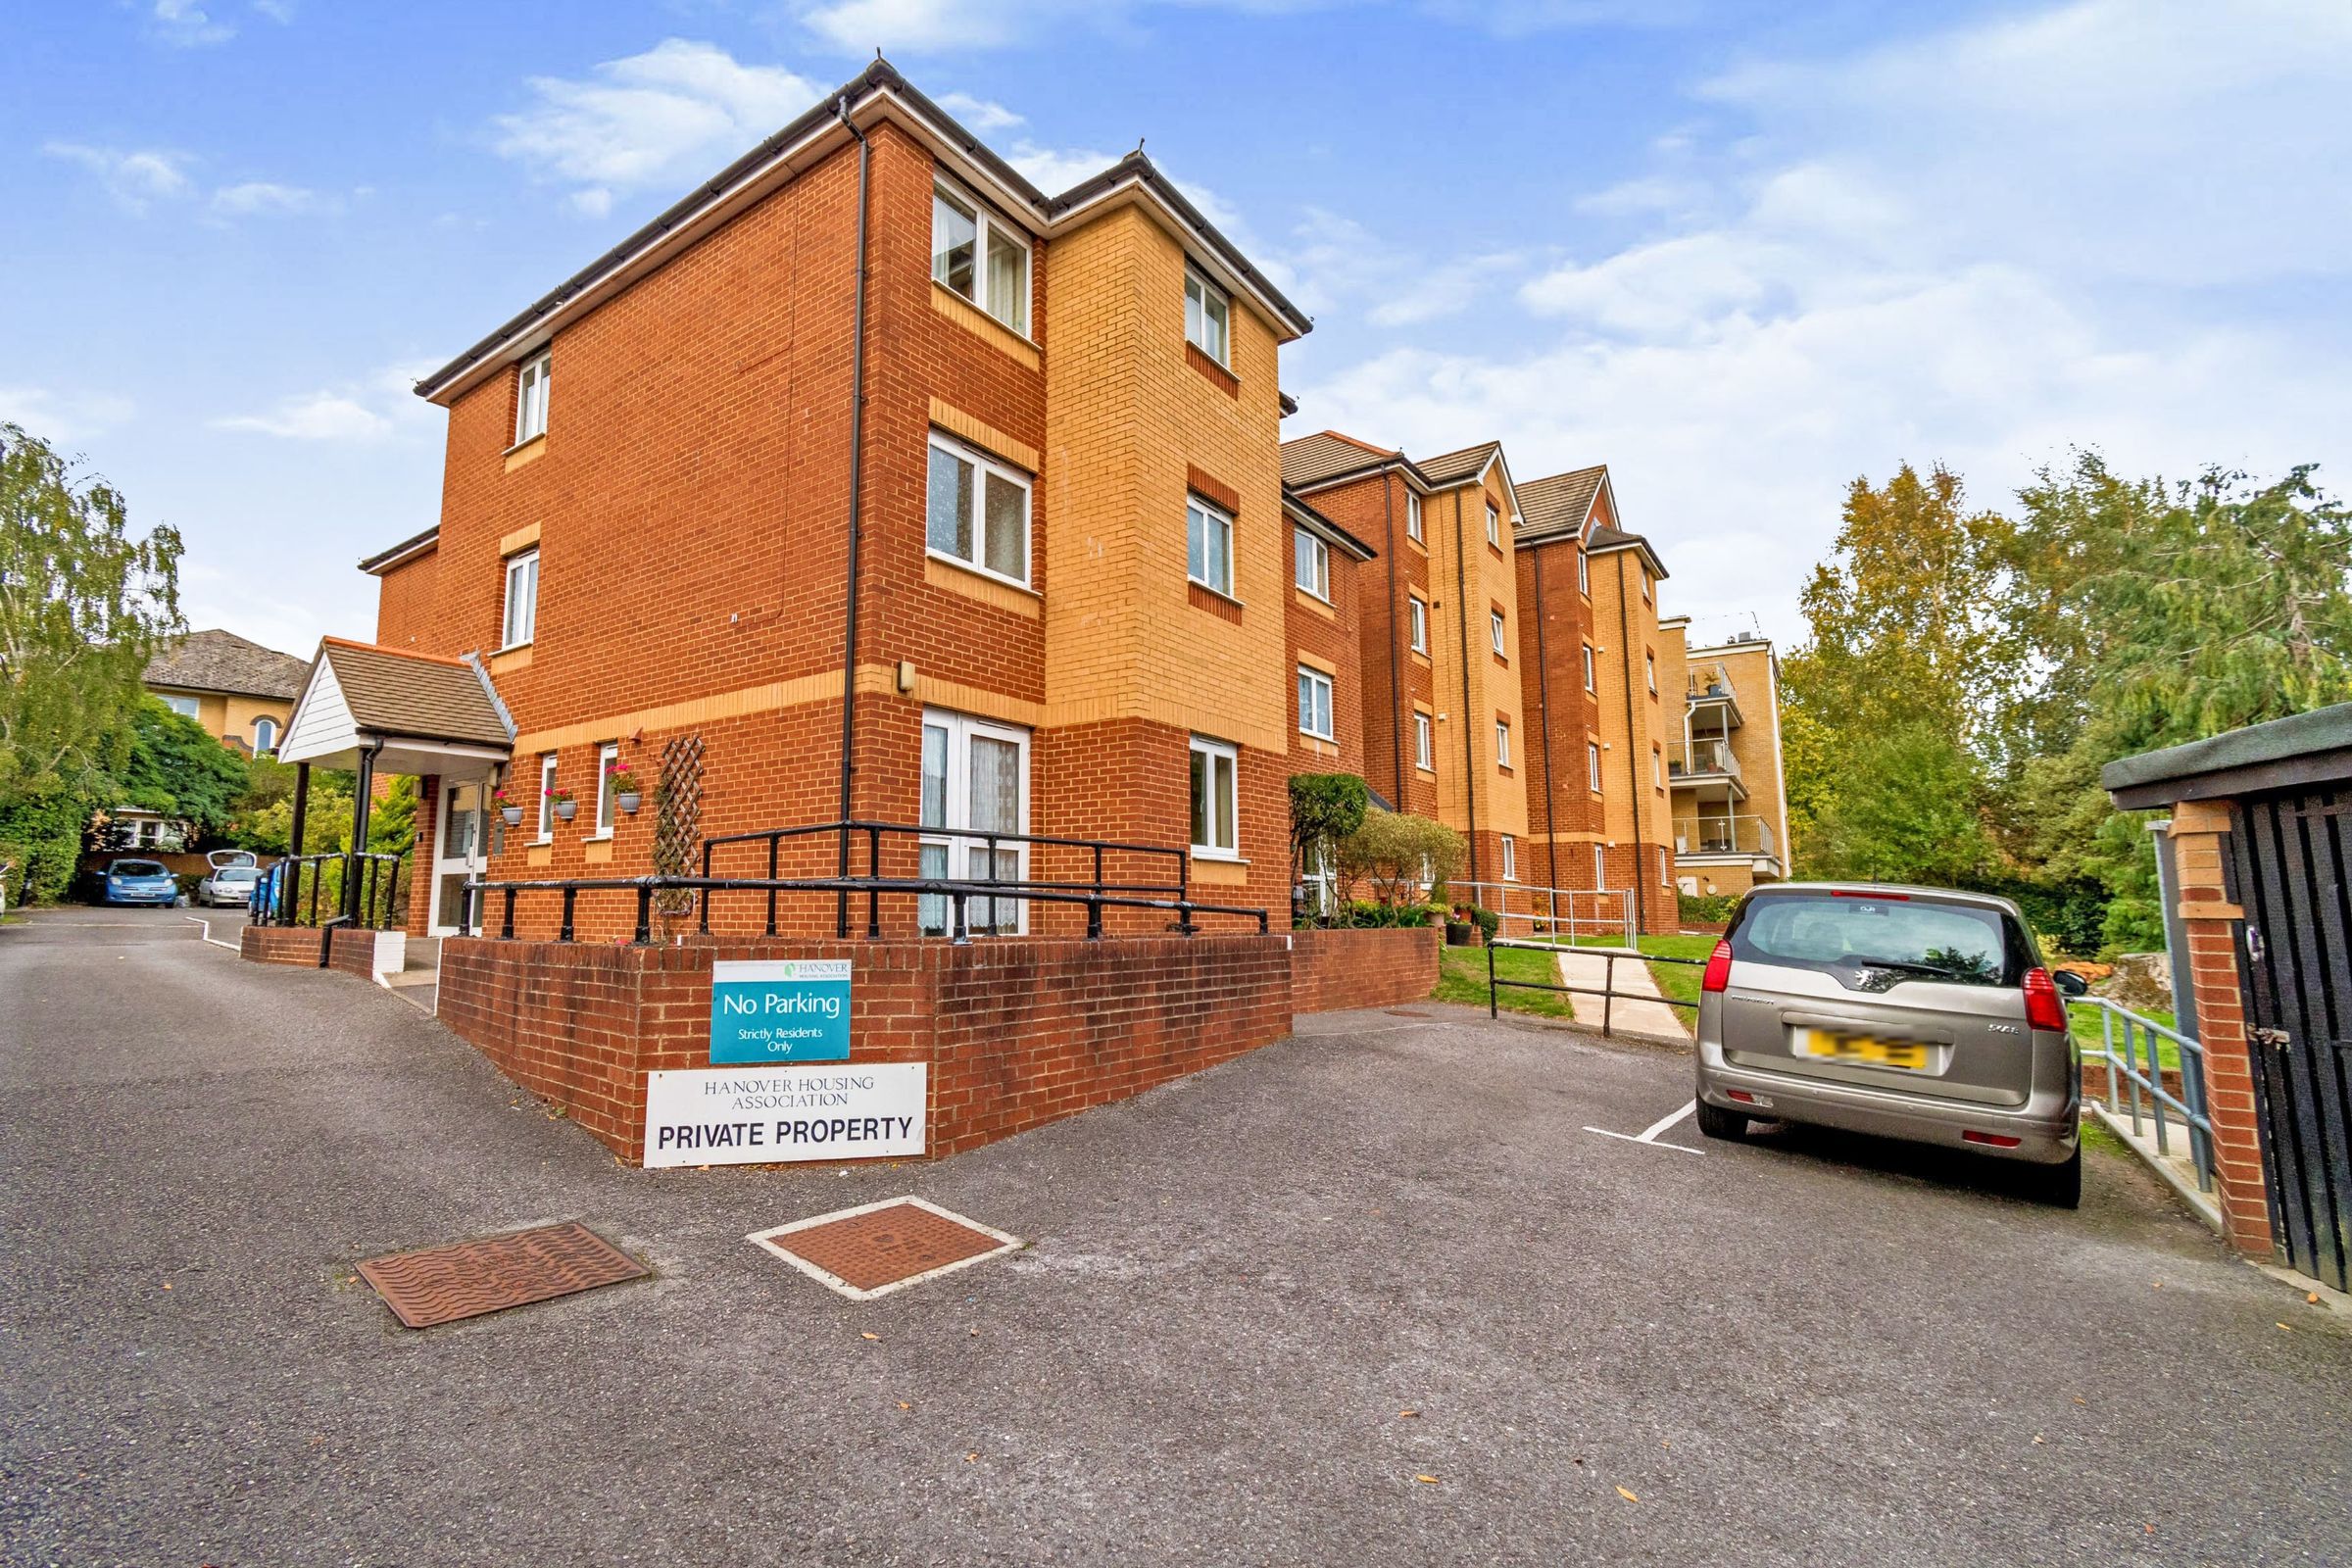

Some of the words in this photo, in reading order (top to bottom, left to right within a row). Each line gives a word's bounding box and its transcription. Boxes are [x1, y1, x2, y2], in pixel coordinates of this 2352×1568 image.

[800, 963, 848, 973] HANOVER
[723, 994, 758, 1015] No
[764, 992, 840, 1019] Parking
[738, 1028, 773, 1042] Strictly
[776, 1027, 823, 1039] Residents
[767, 1041, 794, 1054] Only
[705, 1079, 793, 1095] HANOVER
[799, 1076, 874, 1091] HOUSING
[732, 1093, 849, 1109] ASSOCIATION
[658, 1122, 764, 1151] PRIVATE
[775, 1116, 913, 1145] PROPERTY
